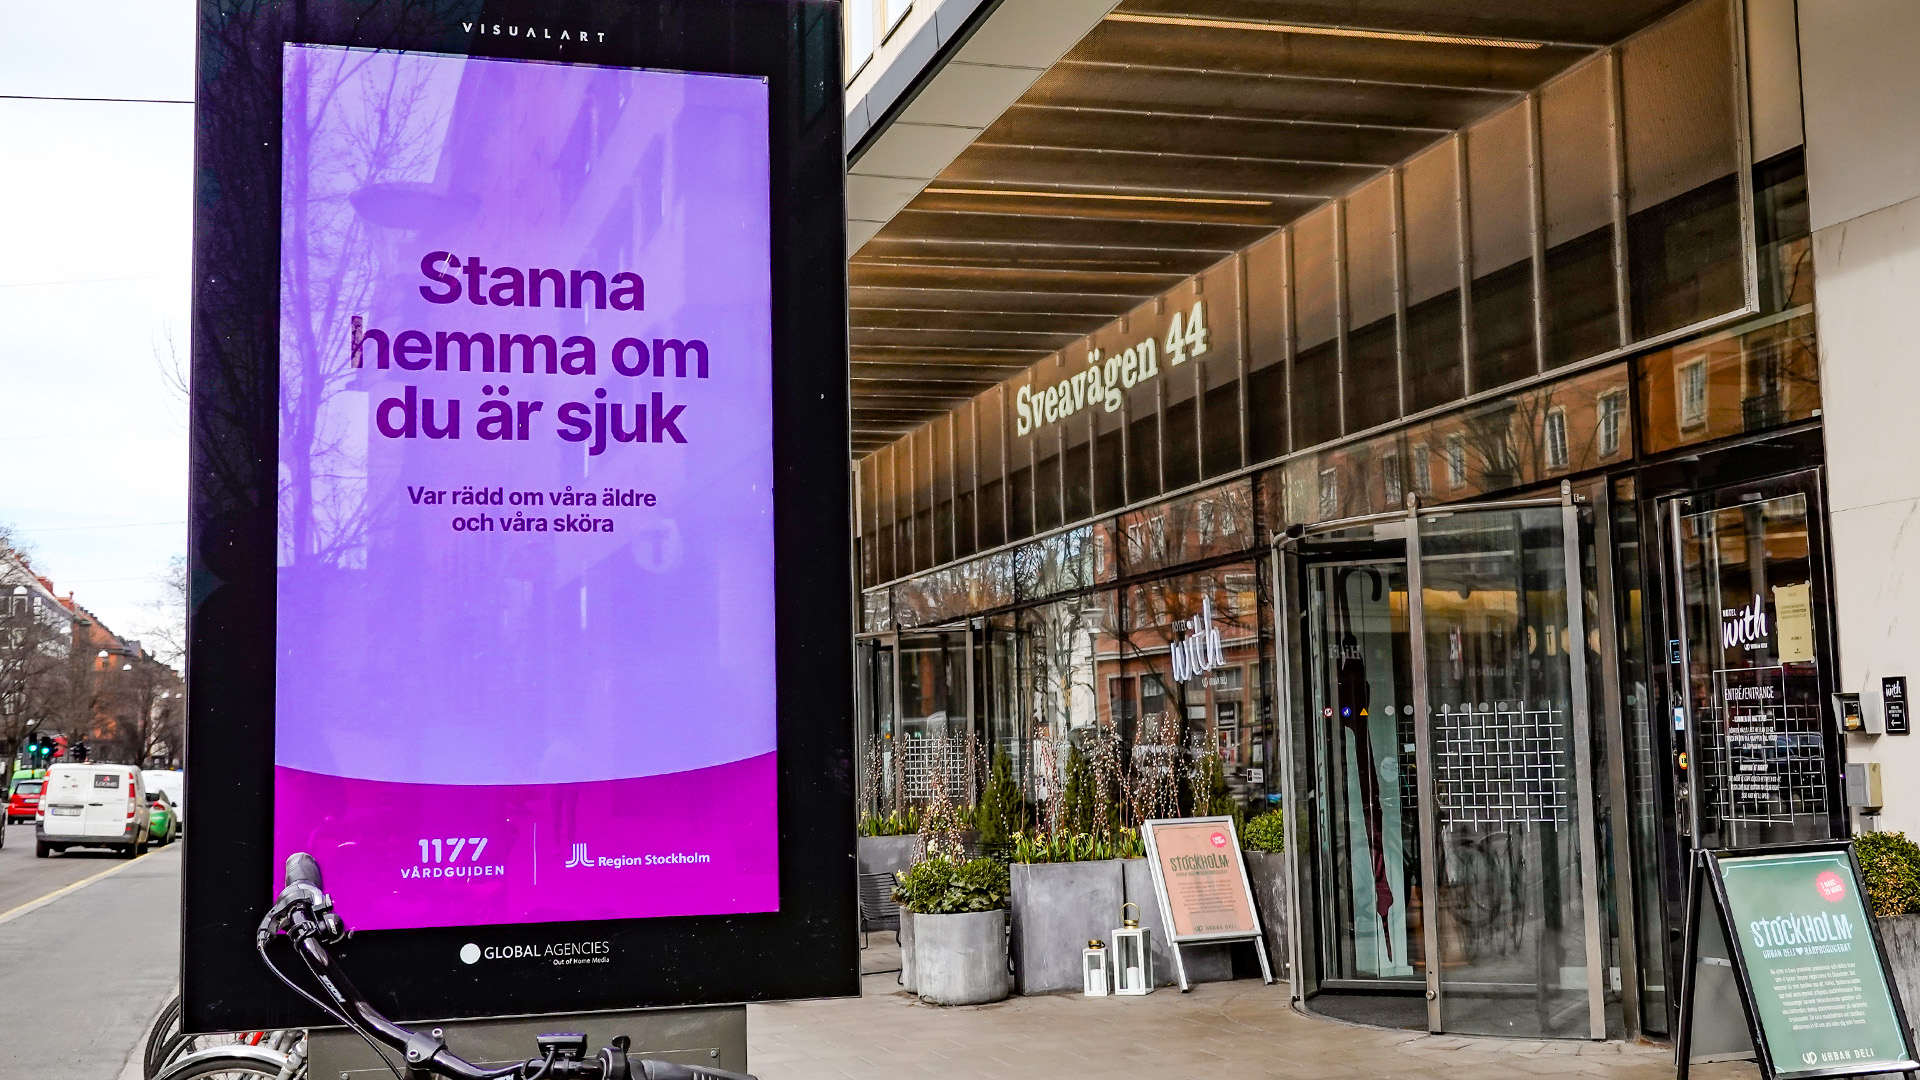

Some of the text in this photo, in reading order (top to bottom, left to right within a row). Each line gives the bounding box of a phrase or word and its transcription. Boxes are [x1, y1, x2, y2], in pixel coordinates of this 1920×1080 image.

[462, 21, 606, 43] VISUALART
[419, 251, 645, 311] Stanna
[351, 315, 709, 379] hemma om
[1016, 301, 1207, 437] Sveavägen 44
[377, 385, 688, 456] du är sjuk
[408, 485, 657, 507] Var rädd om våra äldre
[452, 511, 614, 533] och våra sköra
[1723, 593, 1768, 649] with
[1171, 593, 1226, 683] with
[418, 837, 488, 864] 1177
[598, 852, 710, 868] Region Stockholm
[400, 865, 505, 879] VÅRDGUIDEN
[1169, 852, 1229, 872] STOCKHOLM
[1749, 911, 1853, 948] STOCKHOLM
[484, 940, 610, 960] GLOBAL AGENCIES
[553, 956, 610, 966] Out of Home Media
[1821, 1049, 1852, 1062] URBAN
[1853, 1047, 1875, 1059] DELI
